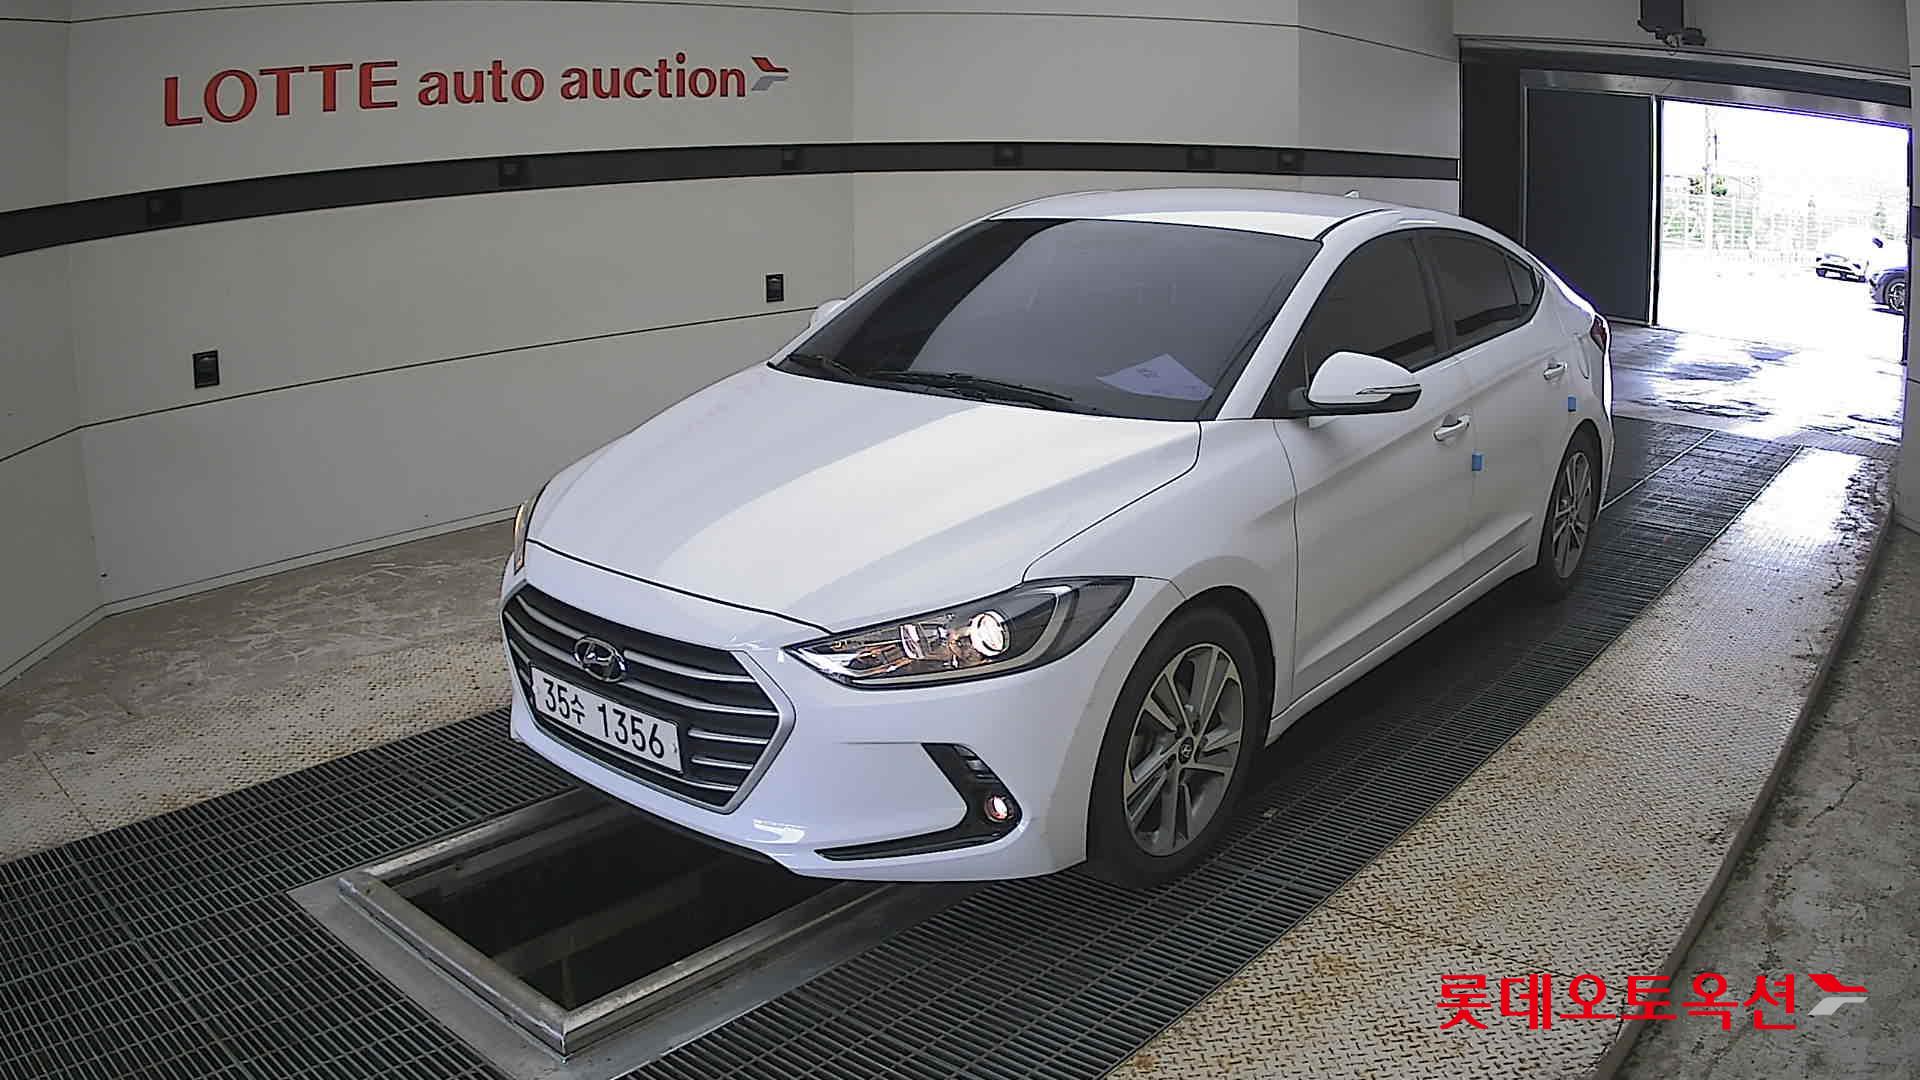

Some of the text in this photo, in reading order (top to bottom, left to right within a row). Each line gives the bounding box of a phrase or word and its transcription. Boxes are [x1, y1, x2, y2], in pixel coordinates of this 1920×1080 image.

[163, 52, 747, 127] LOTTE auto auction
[542, 678, 666, 759] 35수 1356
